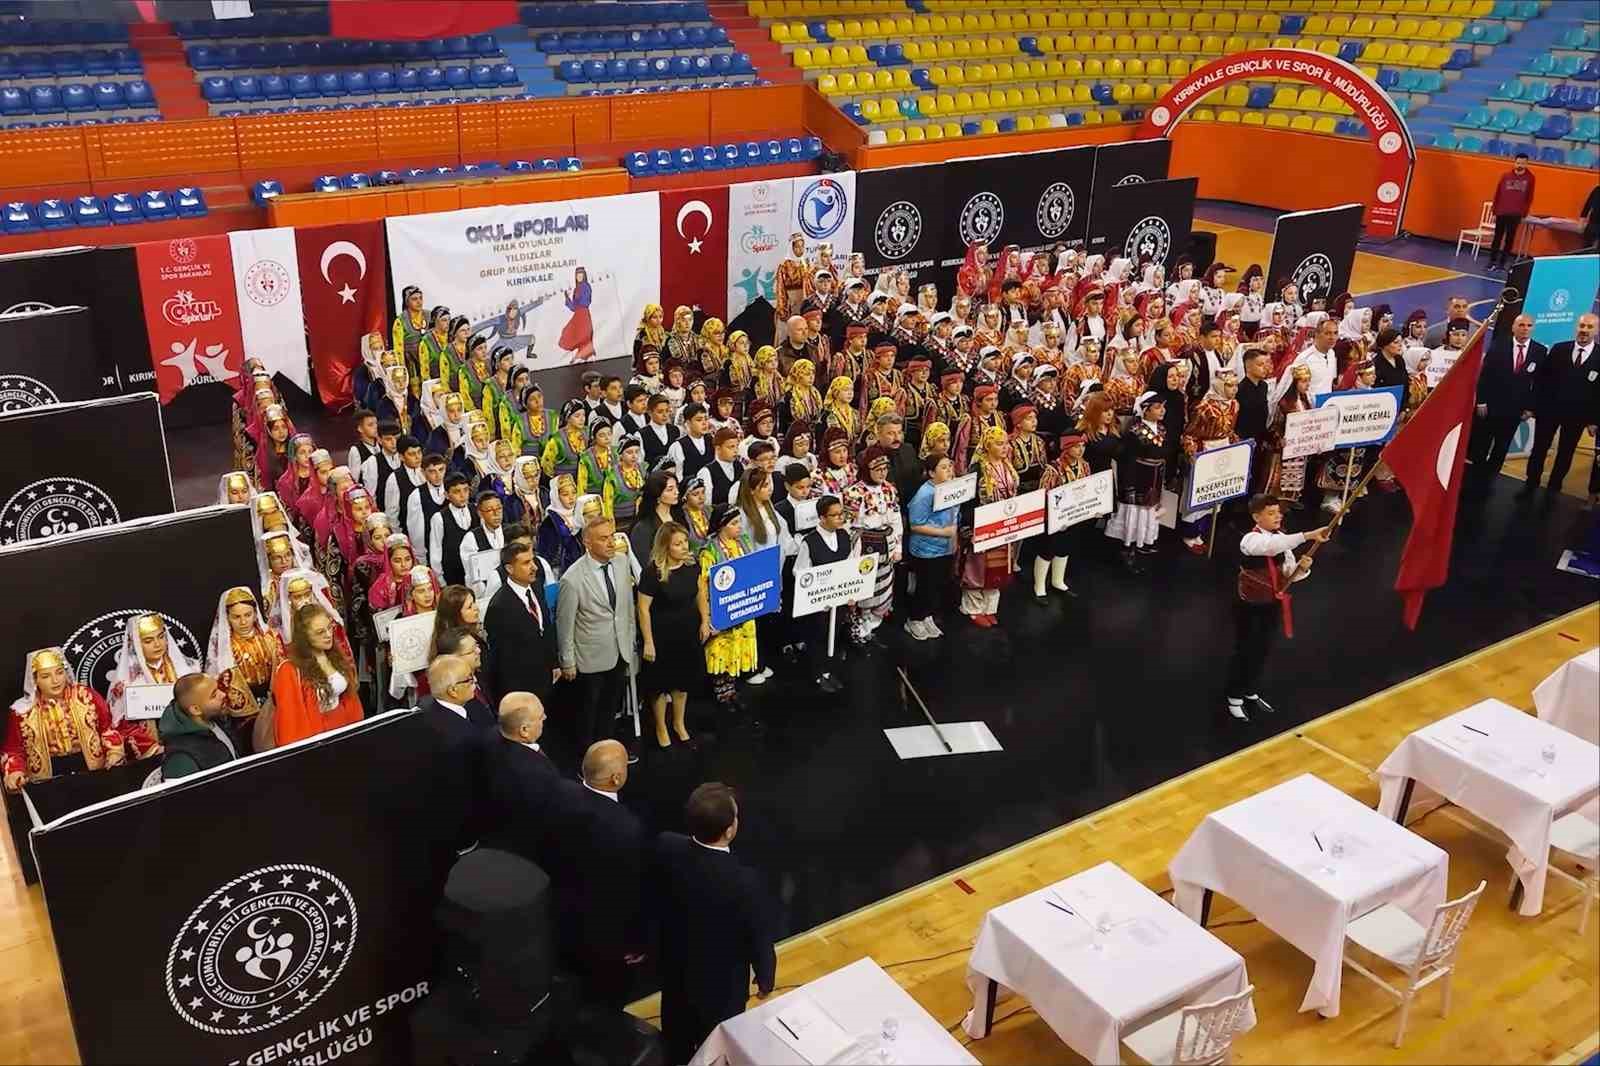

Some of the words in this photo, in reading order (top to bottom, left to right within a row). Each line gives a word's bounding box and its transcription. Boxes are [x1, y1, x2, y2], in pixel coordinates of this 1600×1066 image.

[1173, 68, 1224, 105] KIRIKKALE
[1225, 57, 1272, 76] GENÇLİK
[1275, 59, 1290, 70] VE
[1292, 61, 1323, 78] SPOR
[1323, 68, 1332, 83] İL
[1333, 76, 1389, 130] MÜDÜRLÜĞÜ
[466, 224, 512, 243] OKUL
[513, 214, 589, 239] SPORLARI
[493, 243, 517, 252] HALK
[518, 237, 564, 249] OYUNLARI
[505, 250, 553, 263] YILDIZLAR
[480, 268, 505, 278] GRUP
[506, 273, 554, 288] KIRIKKALE
[1343, 412, 1366, 423] NAMIK
[1368, 410, 1391, 420] KEMAL
[808, 586, 834, 597] NAMIK
[838, 579, 864, 589] KEMAL
[810, 587, 860, 604] ORTAOKULU
[241, 895, 293, 916] GENÇLİK
[294, 898, 310, 911] VE
[305, 906, 324, 931] SPOR
[203, 912, 240, 986] CUMHURİYETİ
[212, 985, 257, 1006] TÜRKİYE
[246, 1018, 341, 1066] GENÇLİK
[343, 1005, 371, 1027] VE
[375, 981, 430, 1015] SPOR
